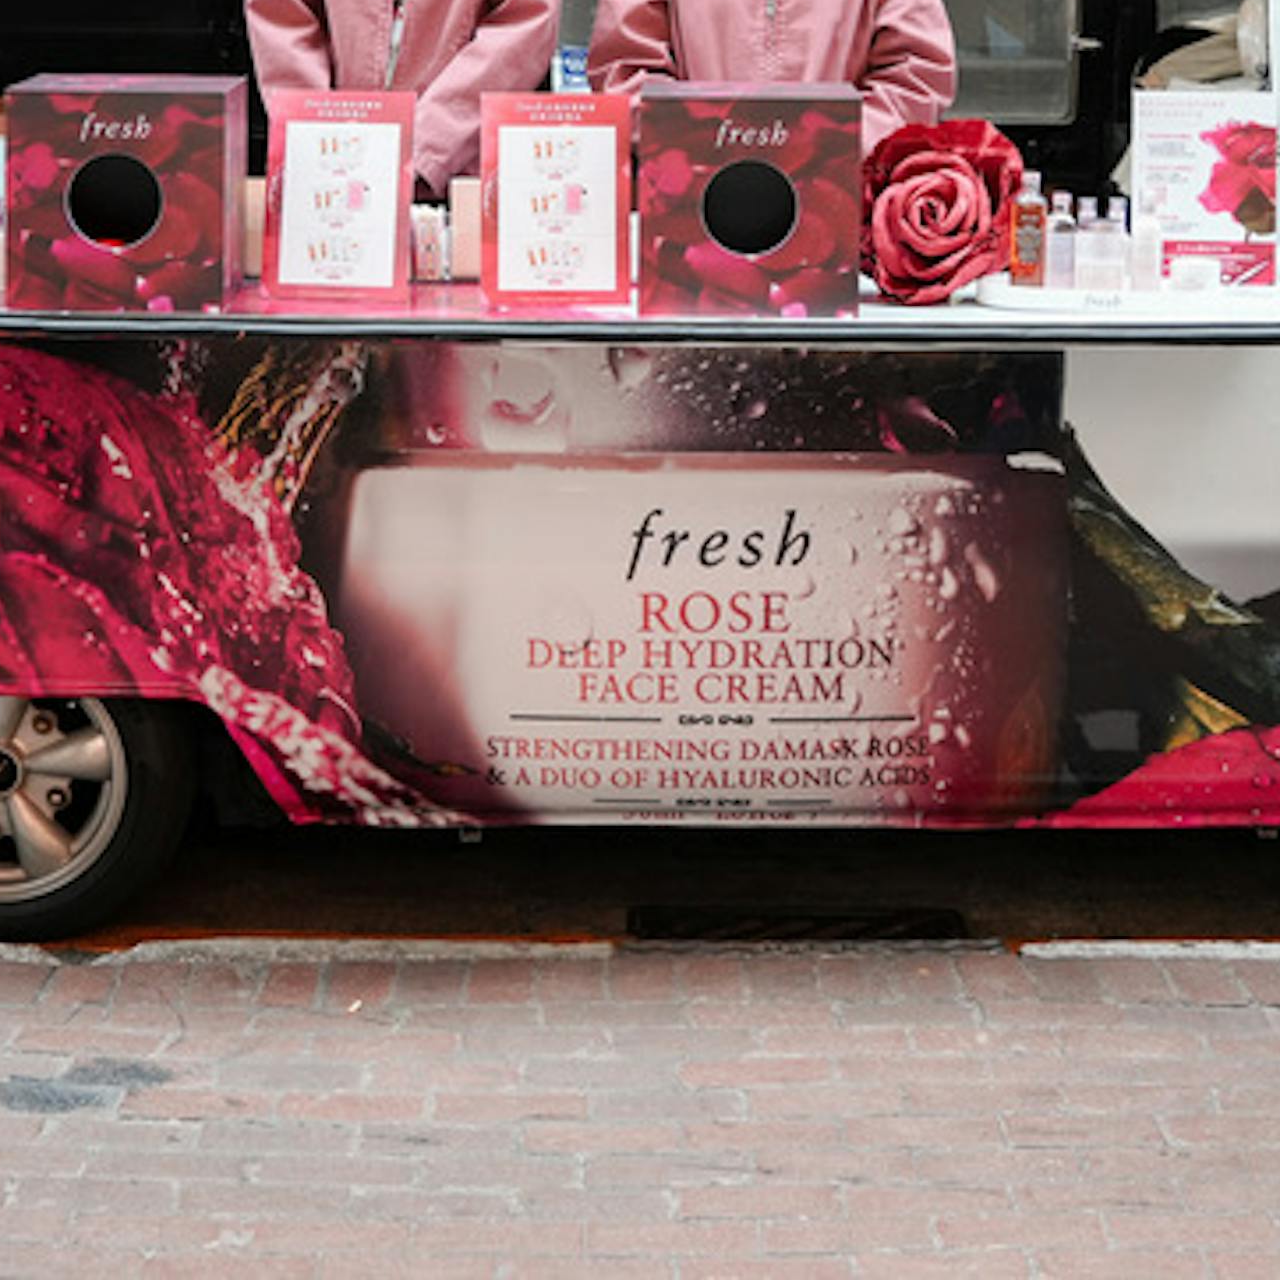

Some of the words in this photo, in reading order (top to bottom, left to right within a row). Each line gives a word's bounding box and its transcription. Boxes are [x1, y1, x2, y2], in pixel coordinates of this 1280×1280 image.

[80, 111, 152, 142] fresh
[716, 119, 789, 148] fresh
[626, 509, 813, 581] fresh
[637, 592, 792, 633] ROSE
[527, 638, 627, 669] DEEP
[642, 636, 895, 670] HYDRATION
[579, 673, 679, 703] FACE
[695, 673, 845, 703] CREAM
[487, 736, 730, 761] STRENGTHENING
[740, 738, 858, 760] DAMASK
[868, 736, 929, 758] ROSE
[486, 765, 506, 787] &
[514, 767, 533, 787] A
[540, 767, 601, 789] DUO
[611, 768, 648, 789] OF
[658, 767, 852, 789] HYALURONIC
